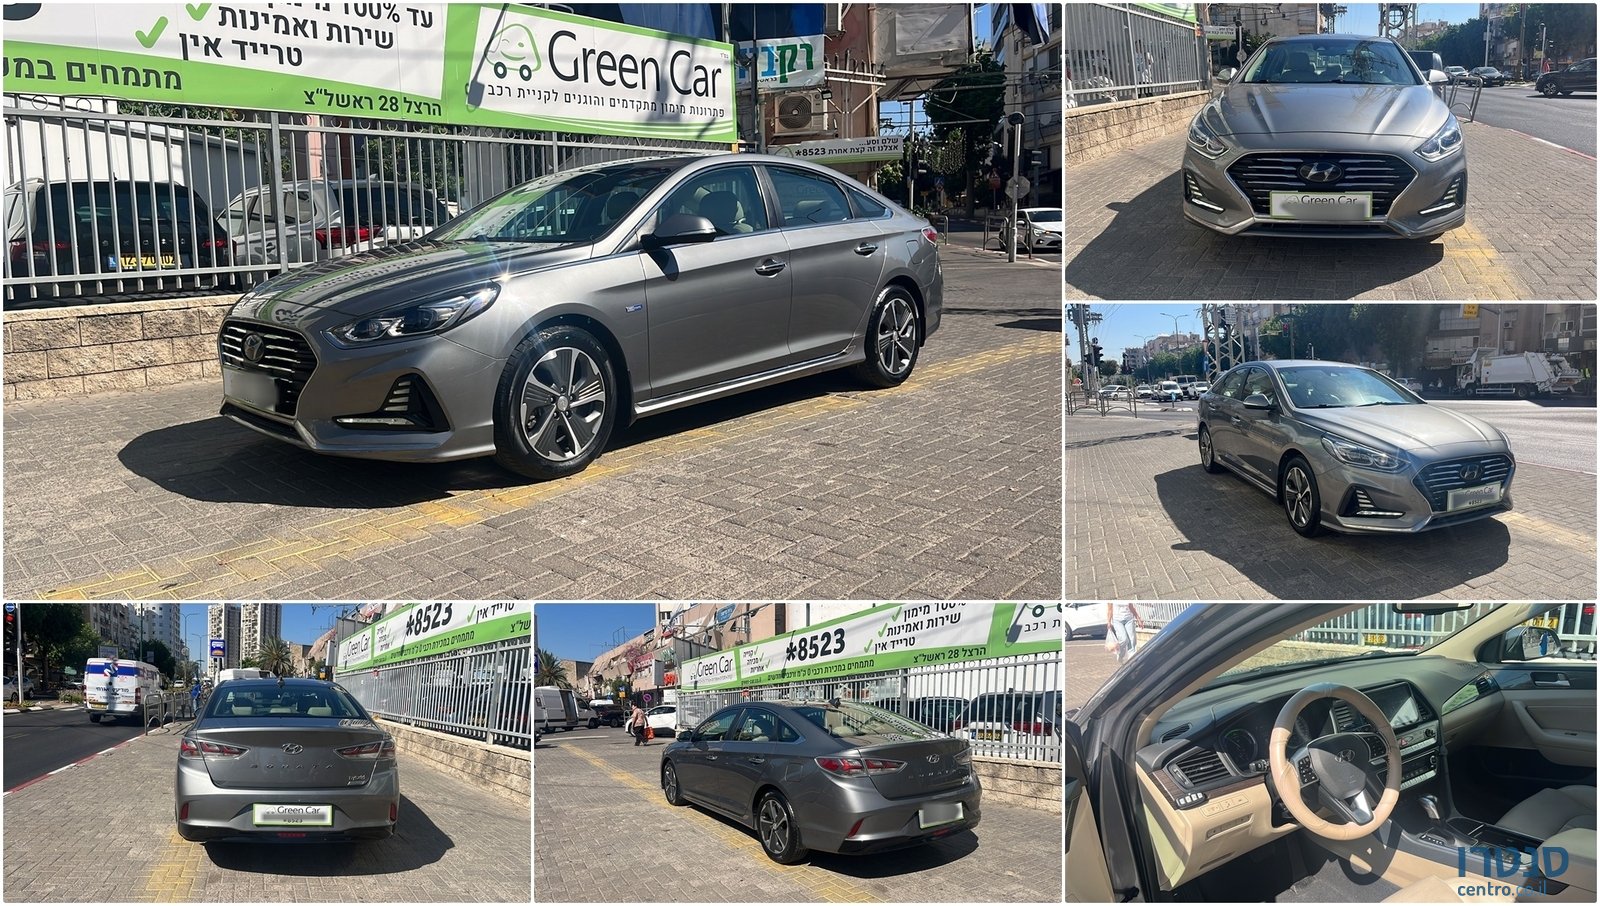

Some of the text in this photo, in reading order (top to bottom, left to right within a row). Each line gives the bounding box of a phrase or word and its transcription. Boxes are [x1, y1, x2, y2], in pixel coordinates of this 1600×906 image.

[406, 8, 433, 28] עד
[219, 6, 394, 49] שירות ואמינות
[179, 33, 303, 67] טרייד אין
[548, 30, 722, 98] Green Car
[66, 61, 182, 90] מתמחים
[378, 95, 399, 112] 28
[403, 96, 442, 116] הרצל
[488, 84, 725, 118] פתרונות מימון מתקדמים והוגנים לקניית רכב
[1301, 195, 1357, 205] Green Car
[476, 607, 489, 624] אין
[904, 604, 930, 622] מימון
[886, 612, 961, 637] שירות ואמינות
[1024, 621, 1047, 632] רכב
[450, 631, 475, 645] מתמחים
[874, 636, 916, 654] טרייד אין
[947, 649, 959, 659] 28
[962, 646, 986, 657] הרצל
[697, 656, 733, 677] Green Car
[811, 668, 824, 676] רכבי
[824, 663, 846, 674] במכירת
[847, 659, 875, 671] מתמחים
[277, 806, 320, 814] Green Car
